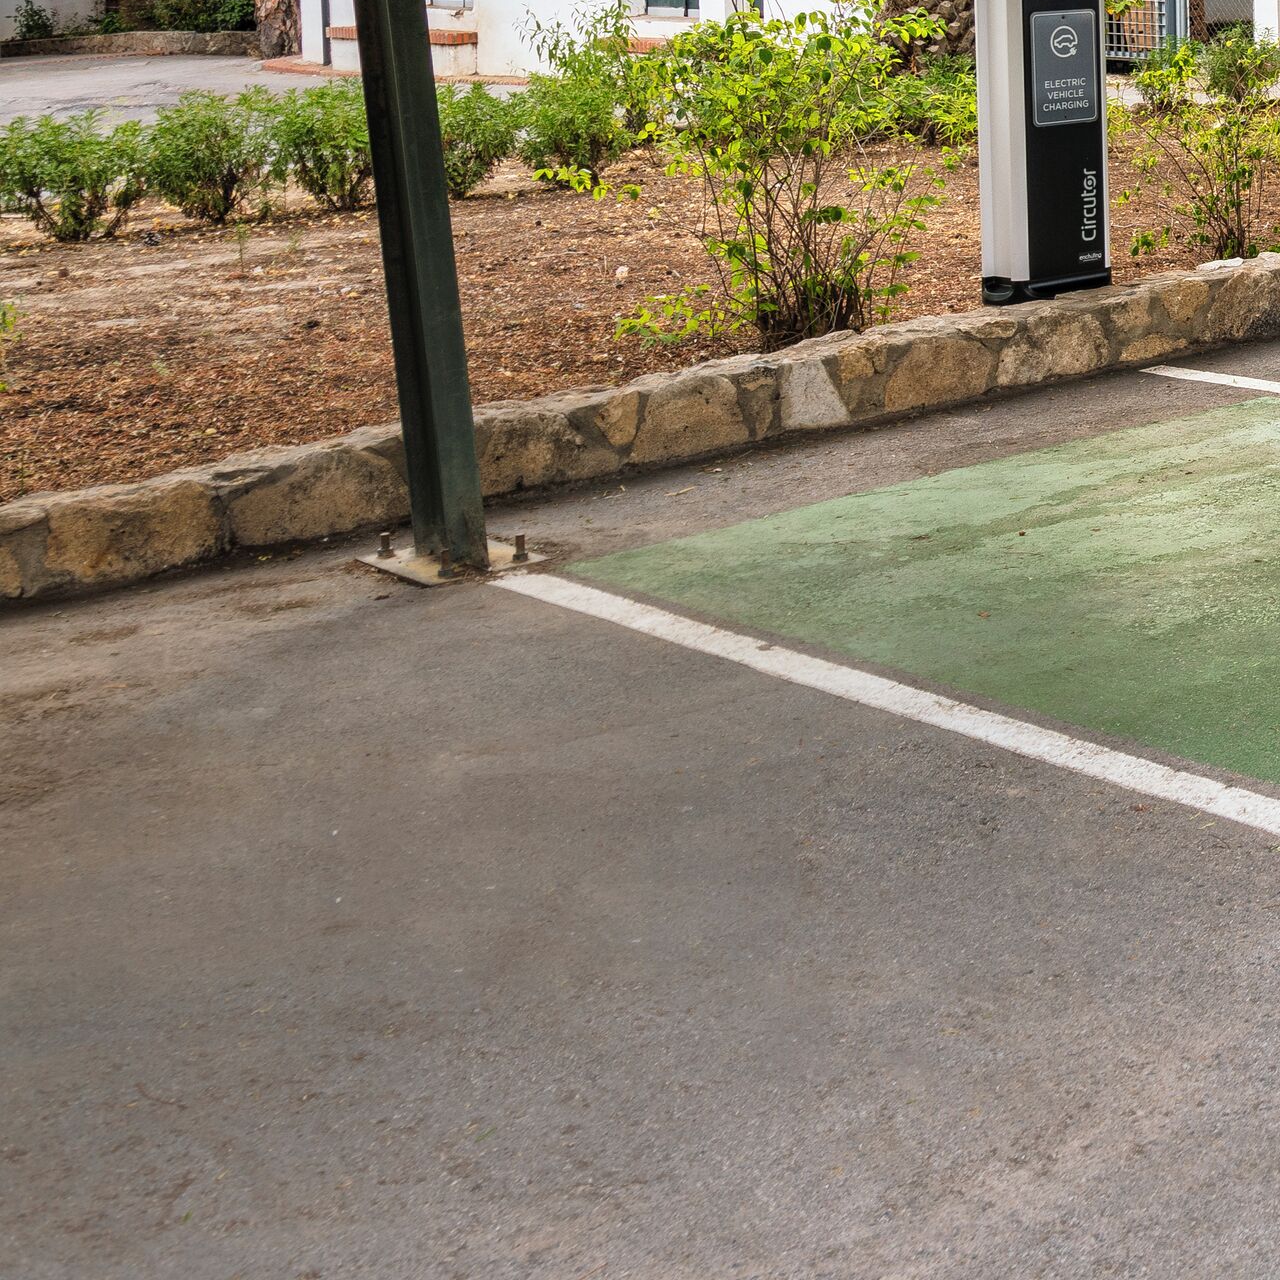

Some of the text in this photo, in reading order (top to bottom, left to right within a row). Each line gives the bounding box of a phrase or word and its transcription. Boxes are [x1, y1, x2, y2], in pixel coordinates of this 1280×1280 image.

[1044, 77, 1086, 89] ELECTRIC
[1047, 88, 1084, 100] VEHICLE
[1042, 99, 1089, 112] CHARGING
